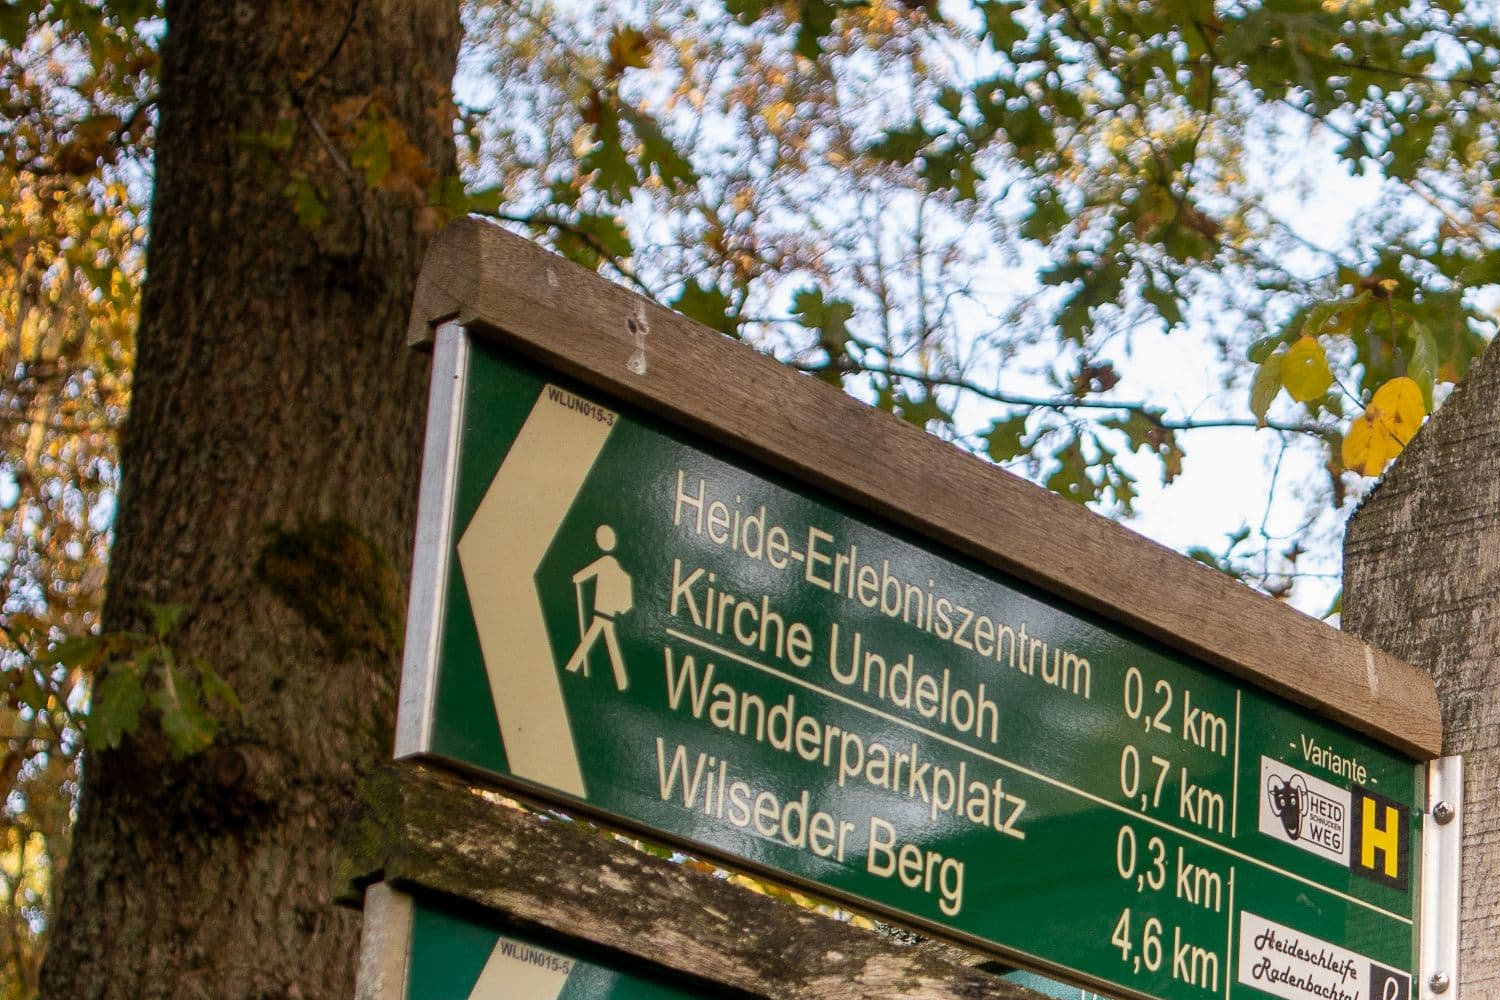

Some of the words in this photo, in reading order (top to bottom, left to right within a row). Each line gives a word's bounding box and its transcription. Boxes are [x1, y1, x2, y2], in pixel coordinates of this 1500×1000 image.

[547, 386, 615, 427] WLUN015-3
[673, 468, 1093, 700] Heide-Erlebniszentrum
[1124, 666, 1172, 734] 0,2
[1184, 691, 1227, 757] km
[669, 557, 813, 668] Kirche
[829, 622, 999, 744] Undeloh
[1120, 744, 1171, 812] 0,7
[1180, 768, 1224, 833] km
[664, 646, 1027, 840] Wanderparkplatz
[1116, 824, 1166, 892] 0,3
[1176, 846, 1222, 912] km
[1301, 734, 1367, 785] Variante
[1309, 823, 1341, 850] WEG
[1310, 796, 1342, 822] HEID
[1361, 796, 1399, 879] H
[655, 736, 855, 866] Wilseder
[866, 816, 966, 917] Berg
[1111, 907, 1163, 972] 4,6
[1173, 926, 1219, 992] km
[1254, 928, 1357, 984] Heideschleife
